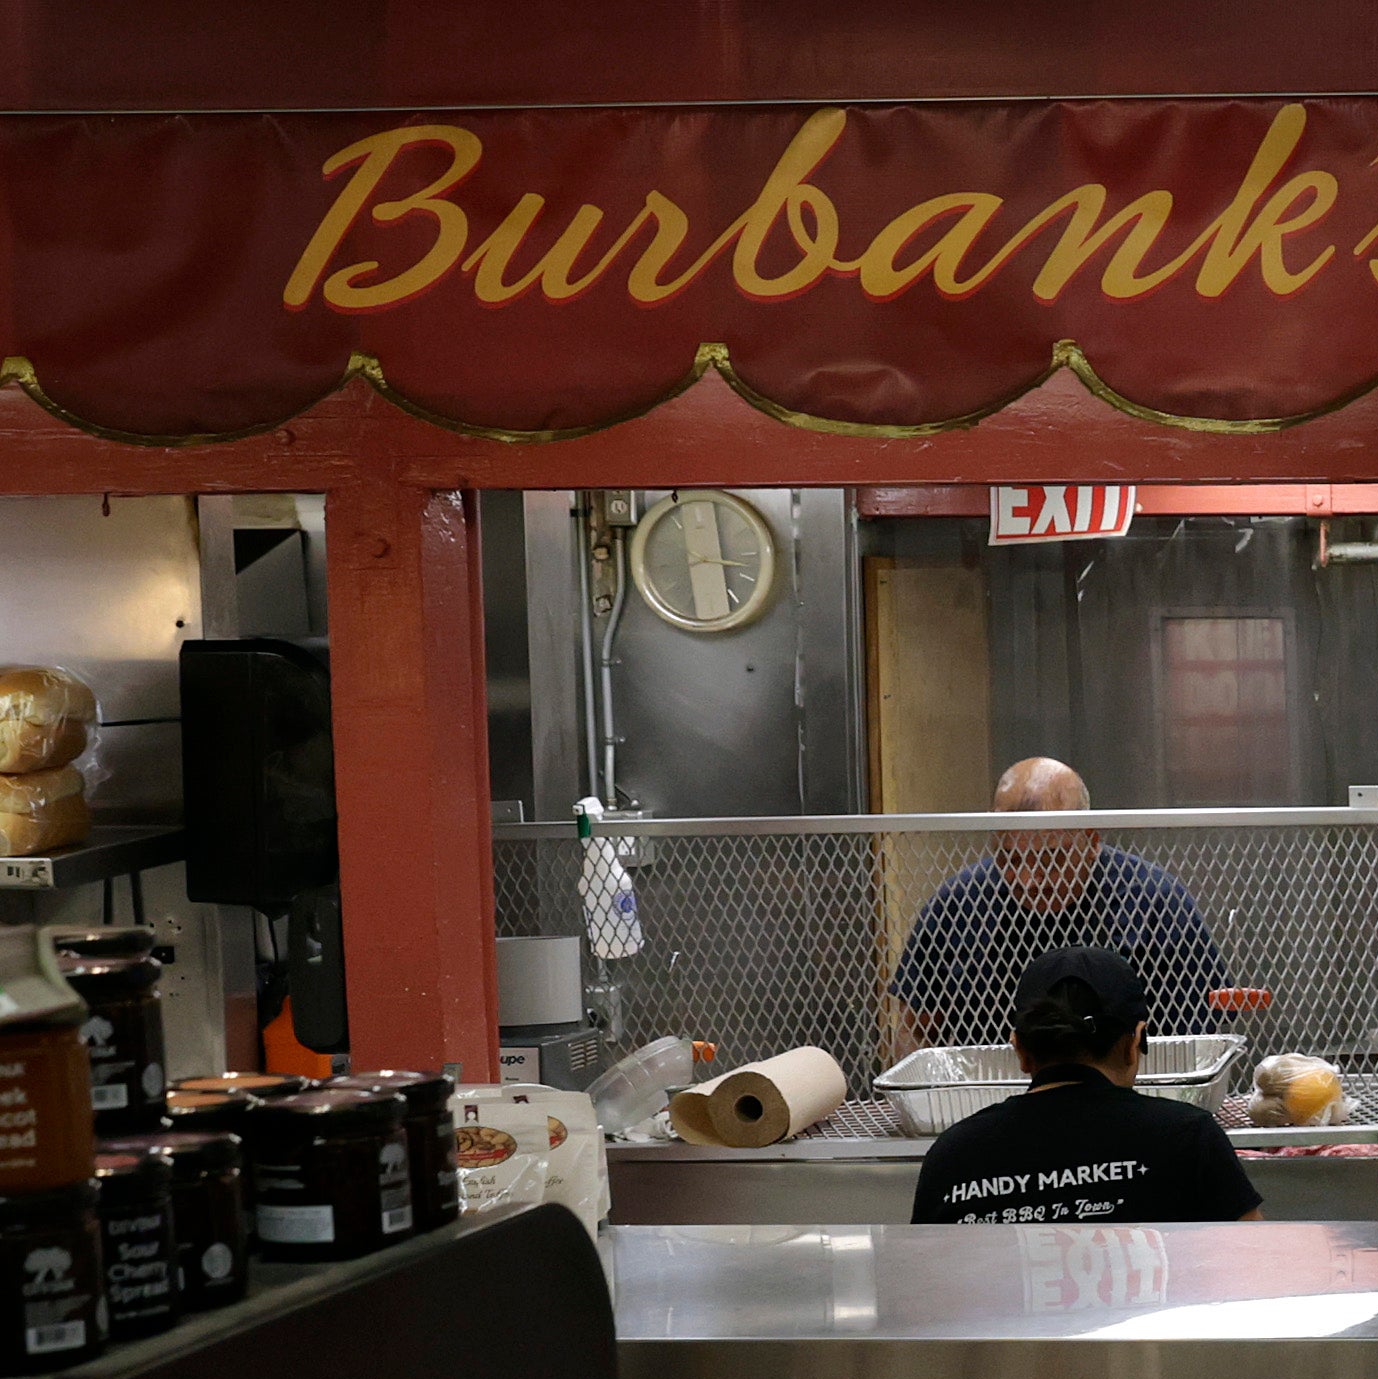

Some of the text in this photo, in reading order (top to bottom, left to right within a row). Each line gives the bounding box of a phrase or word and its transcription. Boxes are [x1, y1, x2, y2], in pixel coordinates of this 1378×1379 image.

[951, 1160, 1138, 1204] HANDY MARKET
[1002, 1203, 1070, 1224] BBQ In
